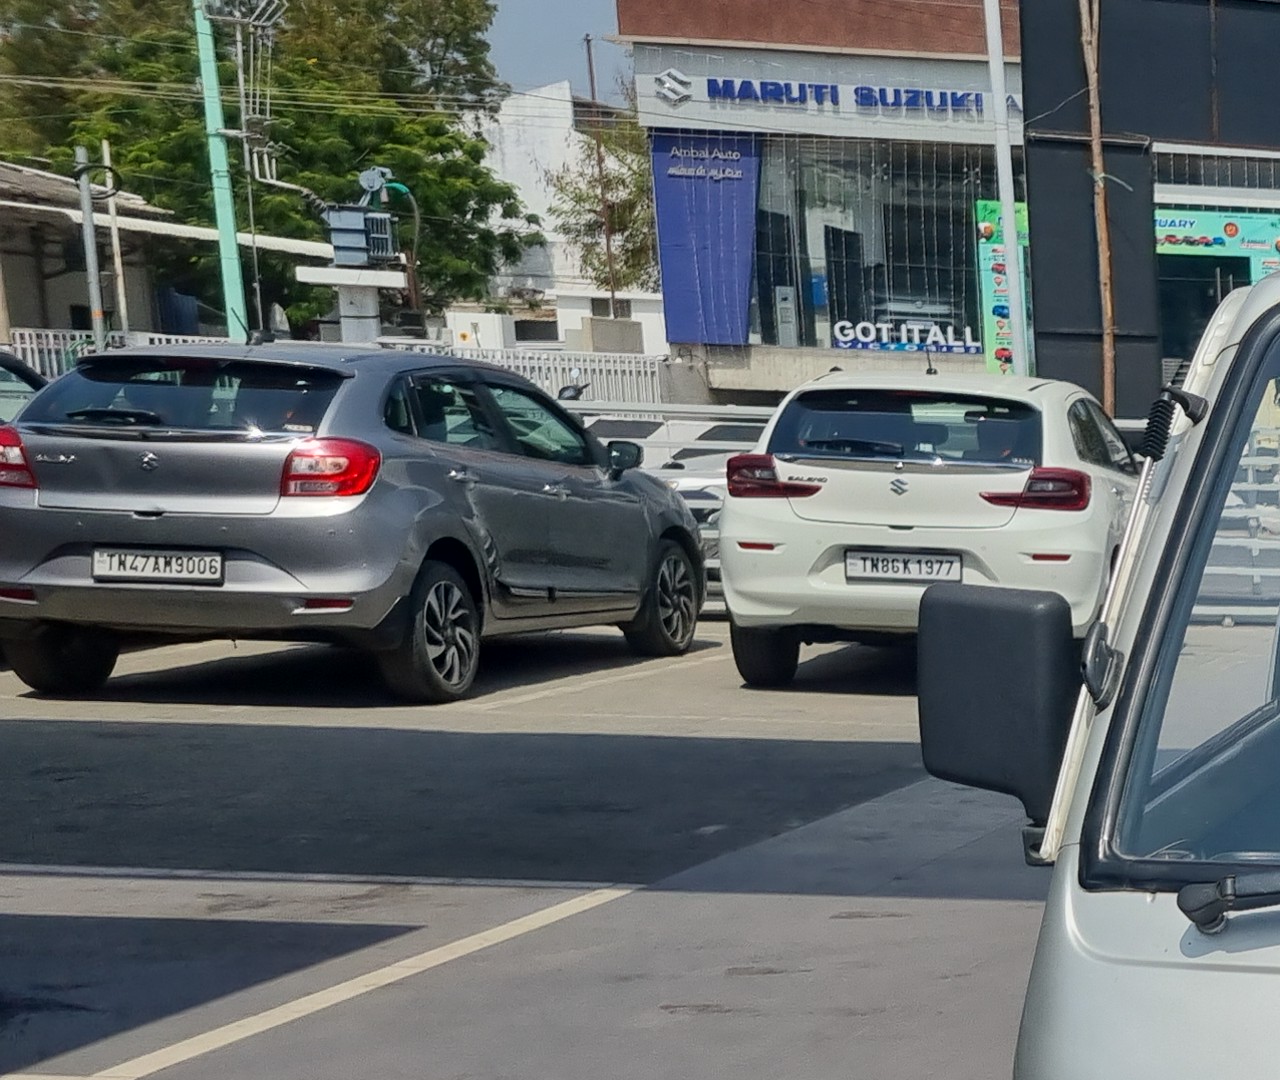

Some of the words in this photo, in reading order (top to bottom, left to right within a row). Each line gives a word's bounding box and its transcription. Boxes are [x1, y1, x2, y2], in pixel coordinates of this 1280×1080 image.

[706, 78, 840, 107] MARUTI
[853, 86, 984, 113] SUZUKI
[670, 146, 708, 159] Ambal
[711, 148, 741, 160] Auto
[833, 320, 893, 343] GOT
